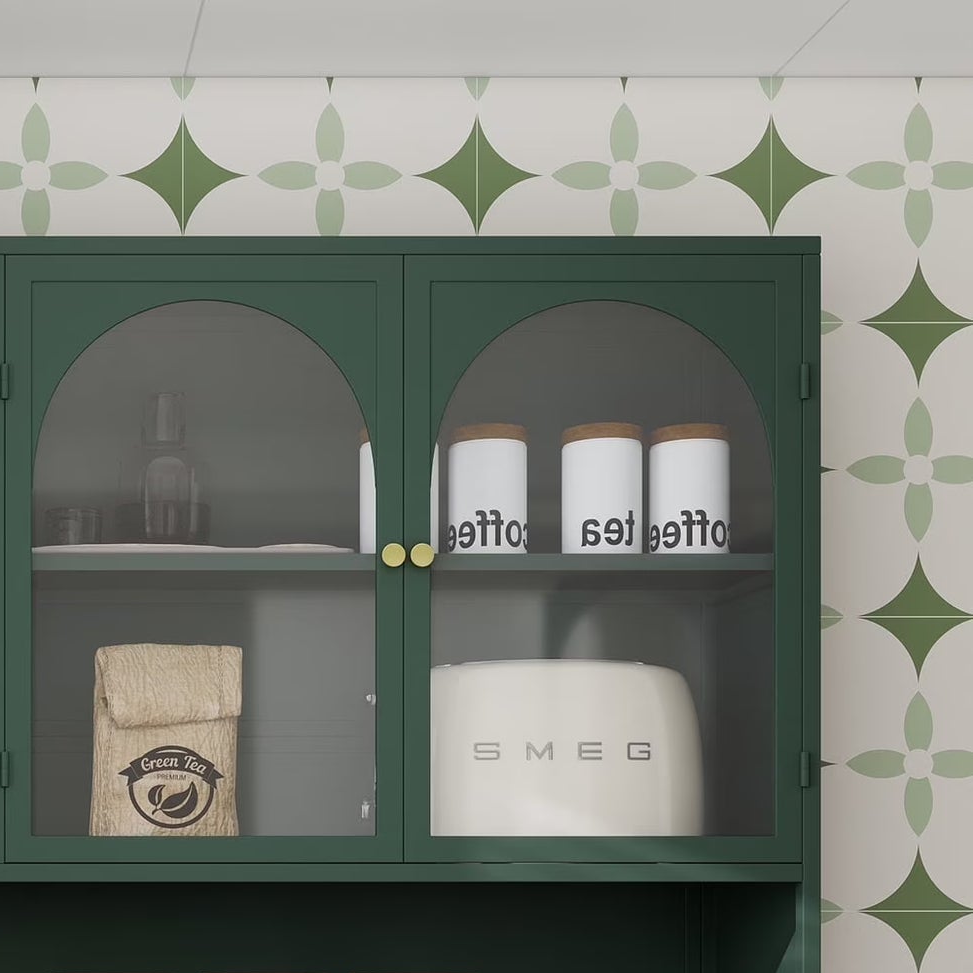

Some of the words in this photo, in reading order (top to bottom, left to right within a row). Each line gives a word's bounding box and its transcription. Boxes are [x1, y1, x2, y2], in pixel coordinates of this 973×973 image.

[473, 741, 651, 761] SMEG
[141, 757, 179, 772] Green
[184, 755, 207, 775] Tea
